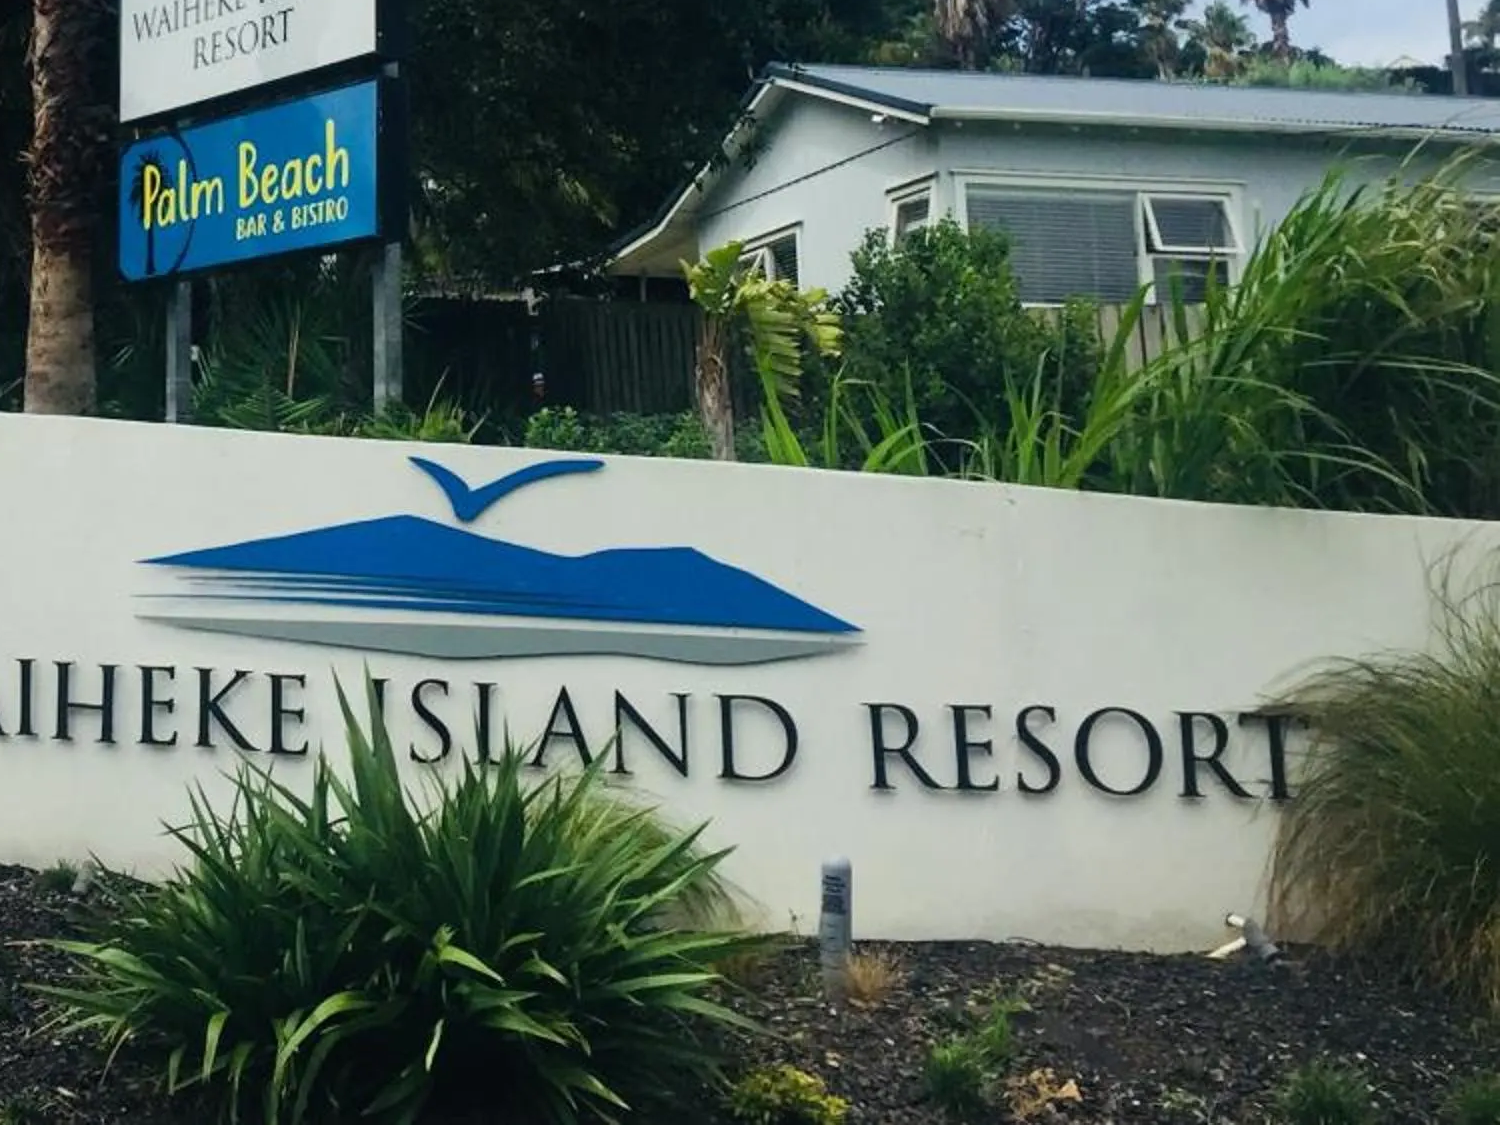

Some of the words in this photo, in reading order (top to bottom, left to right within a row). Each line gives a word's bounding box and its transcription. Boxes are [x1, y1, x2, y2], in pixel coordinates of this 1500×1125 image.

[193, 8, 295, 69] RESORT
[143, 160, 223, 230] Palm
[239, 120, 350, 208] Beach
[236, 217, 267, 241] BAR
[273, 214, 286, 234] &
[291, 198, 349, 230] BISTRO
[861, 703, 1310, 800] RESORT
